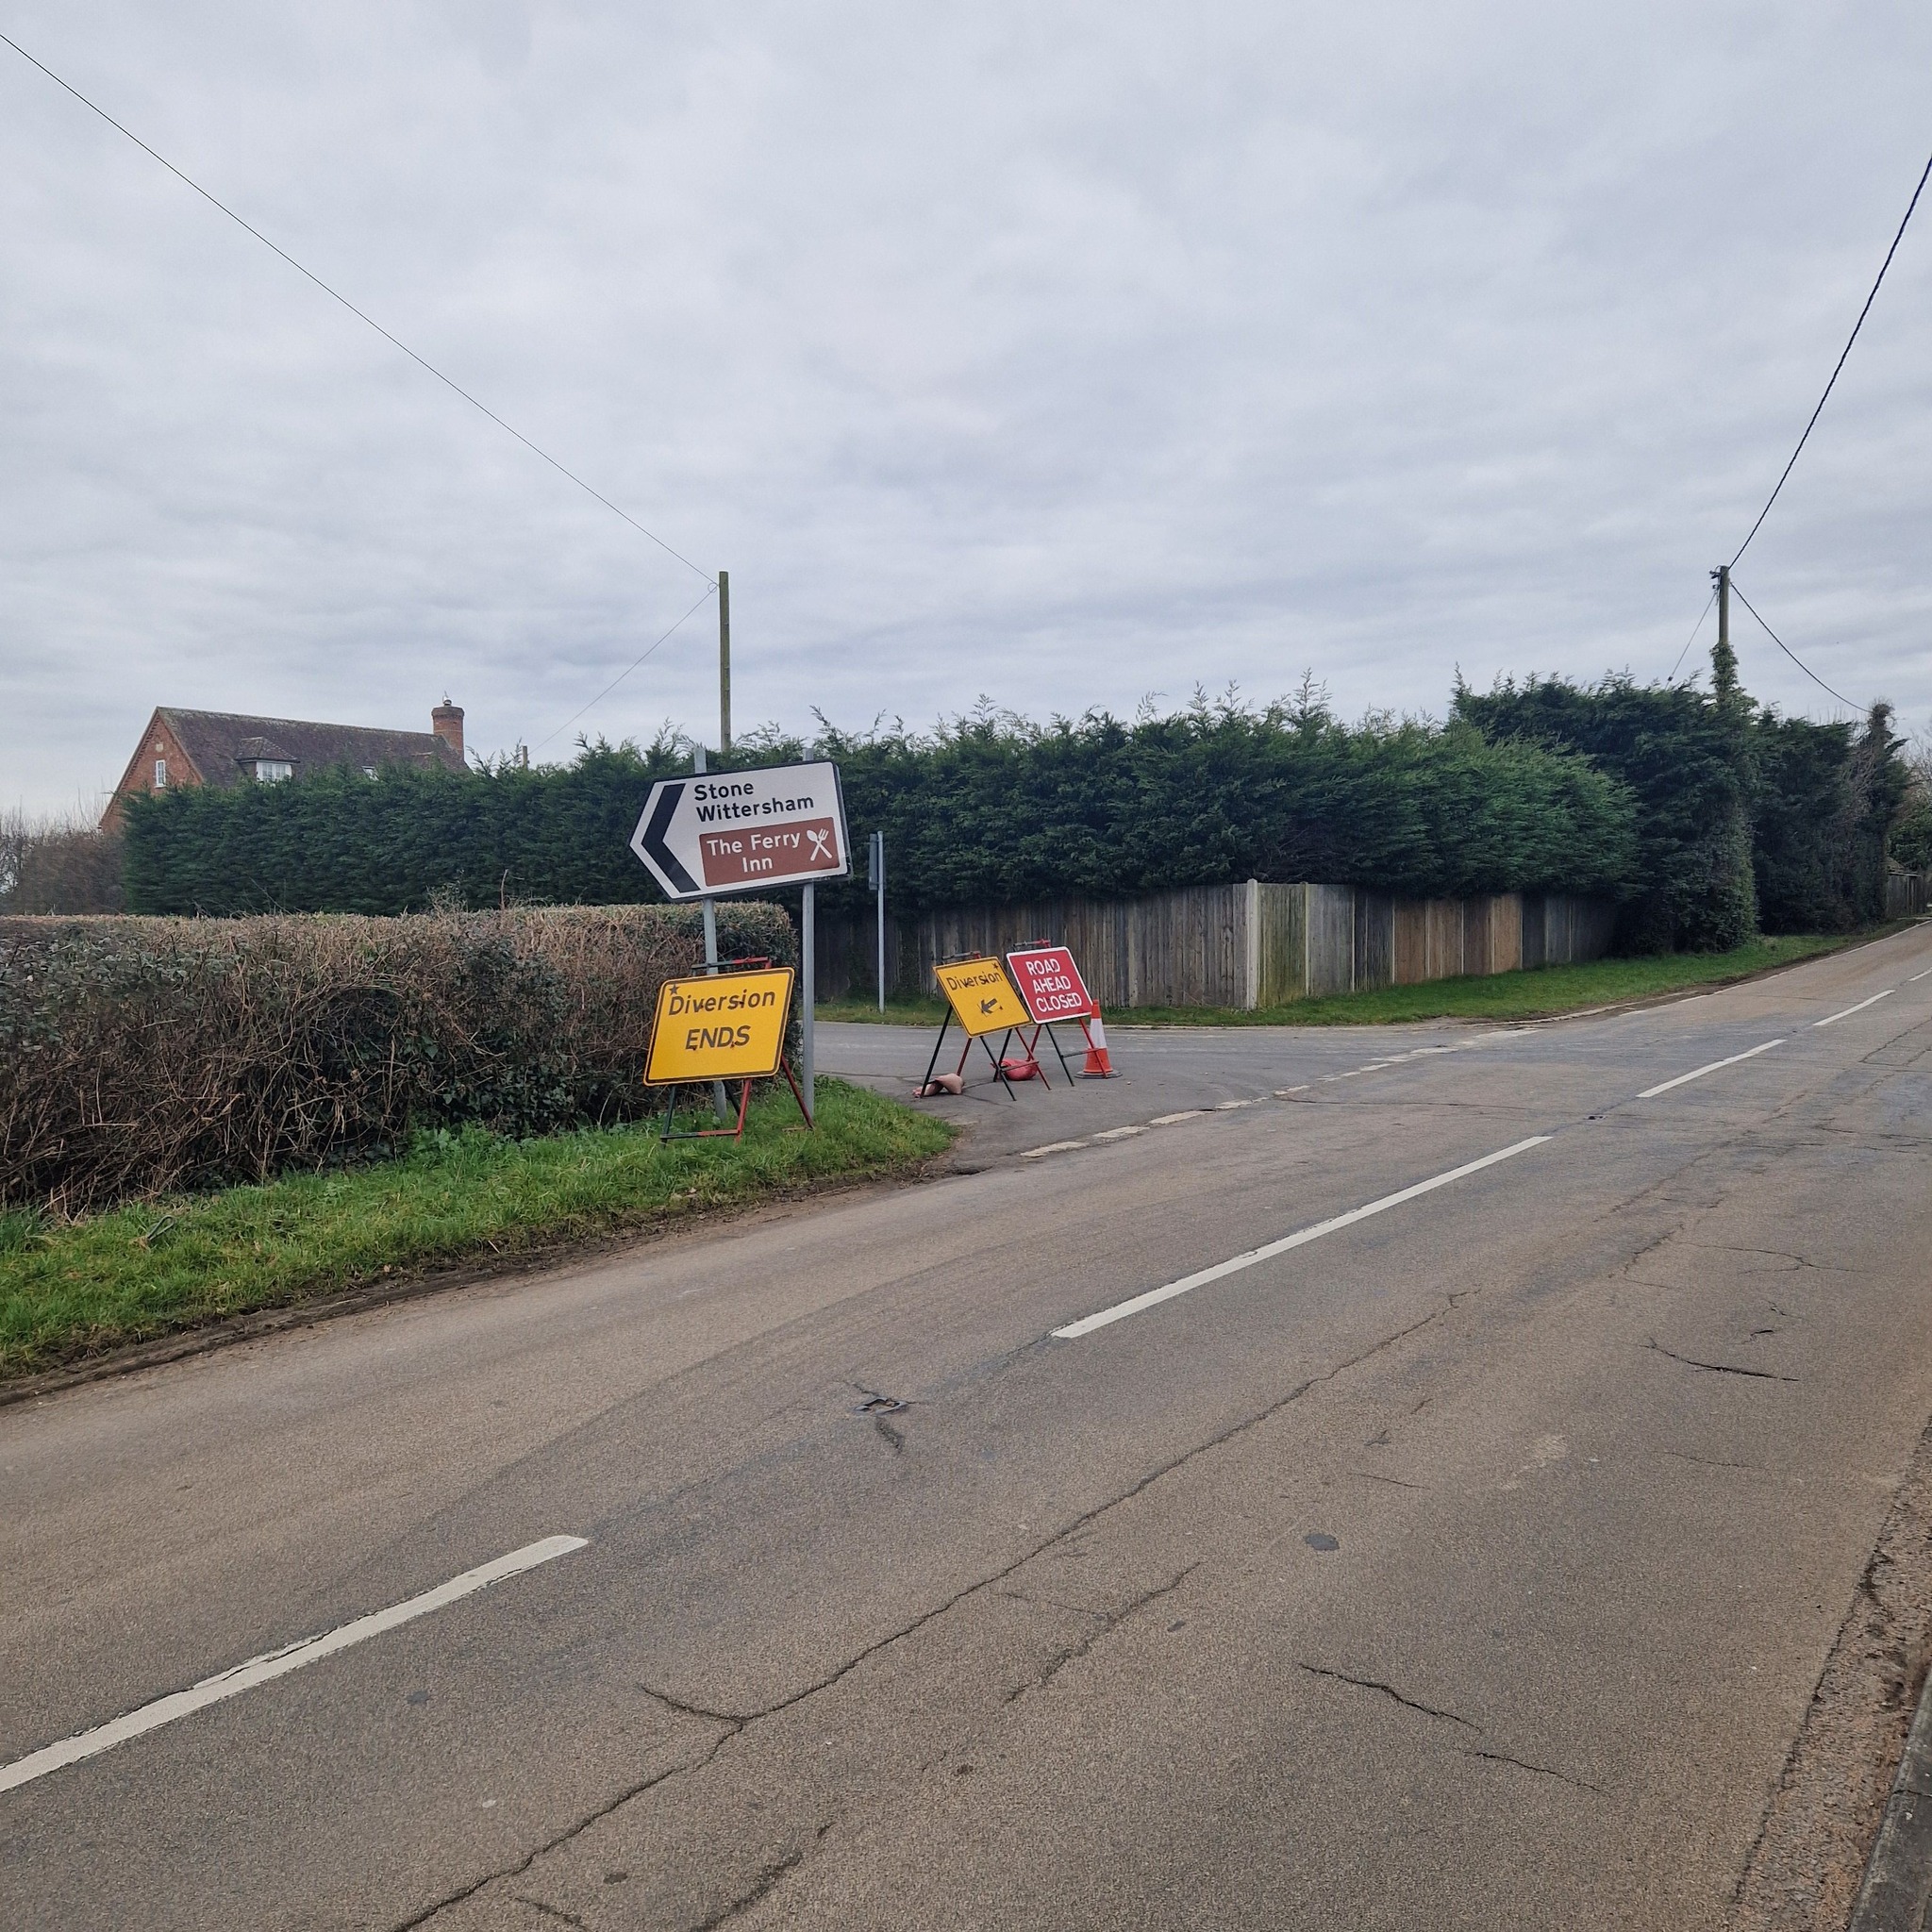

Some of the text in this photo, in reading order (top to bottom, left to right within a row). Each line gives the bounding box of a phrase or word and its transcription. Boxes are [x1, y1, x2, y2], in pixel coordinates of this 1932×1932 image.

[694, 782, 754, 801] Stone
[696, 795, 814, 822] Wittersham
[707, 832, 801, 857] The Ferry
[742, 857, 773, 873] Inn
[1025, 958, 1061, 975] ROAD
[945, 970, 1003, 991] Diversion
[1032, 975, 1072, 994] AHEAD
[668, 989, 775, 1015] Diversion
[1036, 992, 1082, 1013] CLOSED
[685, 1024, 751, 1050] ENDS
